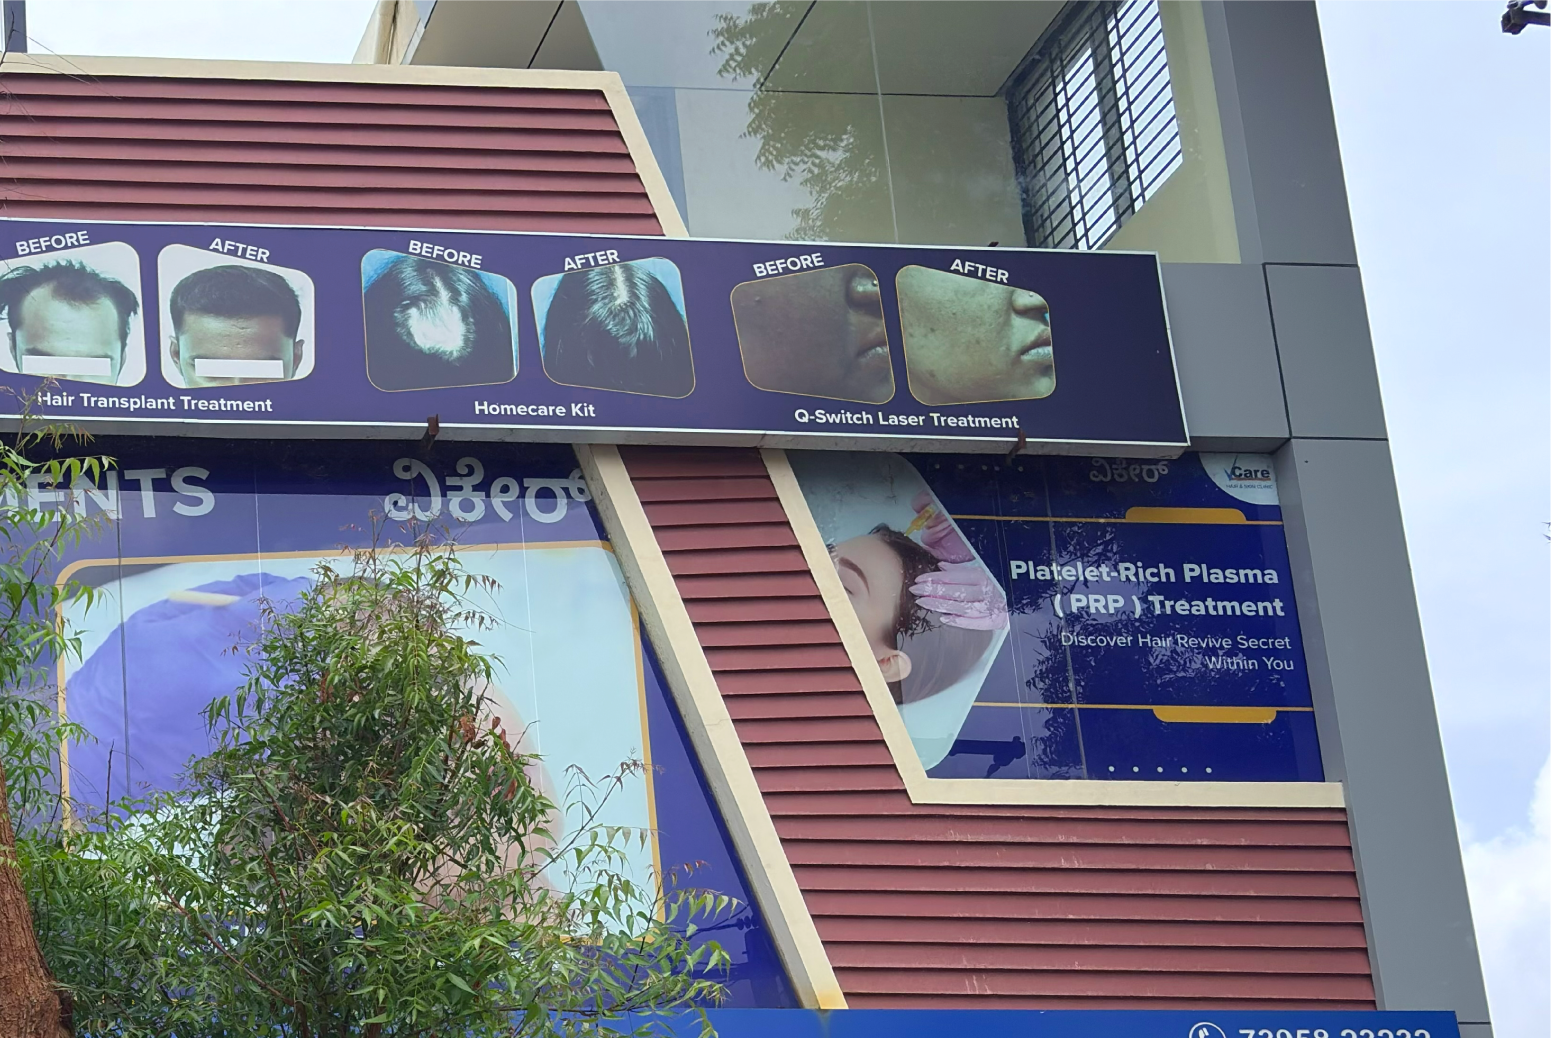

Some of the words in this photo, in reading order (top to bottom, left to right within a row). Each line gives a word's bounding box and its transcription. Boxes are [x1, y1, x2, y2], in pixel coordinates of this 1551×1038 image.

[15, 230, 91, 256] BEFORE
[209, 237, 271, 264] AFTER
[408, 239, 483, 269] BEFORE
[563, 249, 620, 271] AFTER
[752, 252, 825, 278] BEFORE
[950, 258, 1010, 284] AFTER
[37, 391, 75, 408] Hair
[80, 392, 176, 415] Transplant
[180, 394, 273, 413] Treatment
[474, 401, 568, 418] Homecare
[571, 402, 597, 418] Kit
[794, 408, 874, 427] Q-Switch
[878, 411, 926, 428] Laser
[929, 412, 1020, 430] Treatment
[1010, 559, 1176, 585] Platelet-Rich
[1183, 562, 1280, 585] Plasma
[1070, 594, 1125, 615] PRP
[1153, 594, 1285, 617] Treatment
[1061, 632, 1133, 647] Discover
[1138, 632, 1172, 648] Hair
[1177, 633, 1232, 649] Revive
[1237, 634, 1292, 650] Secret
[1205, 655, 1258, 670] Within
[1262, 656, 1295, 671] You
